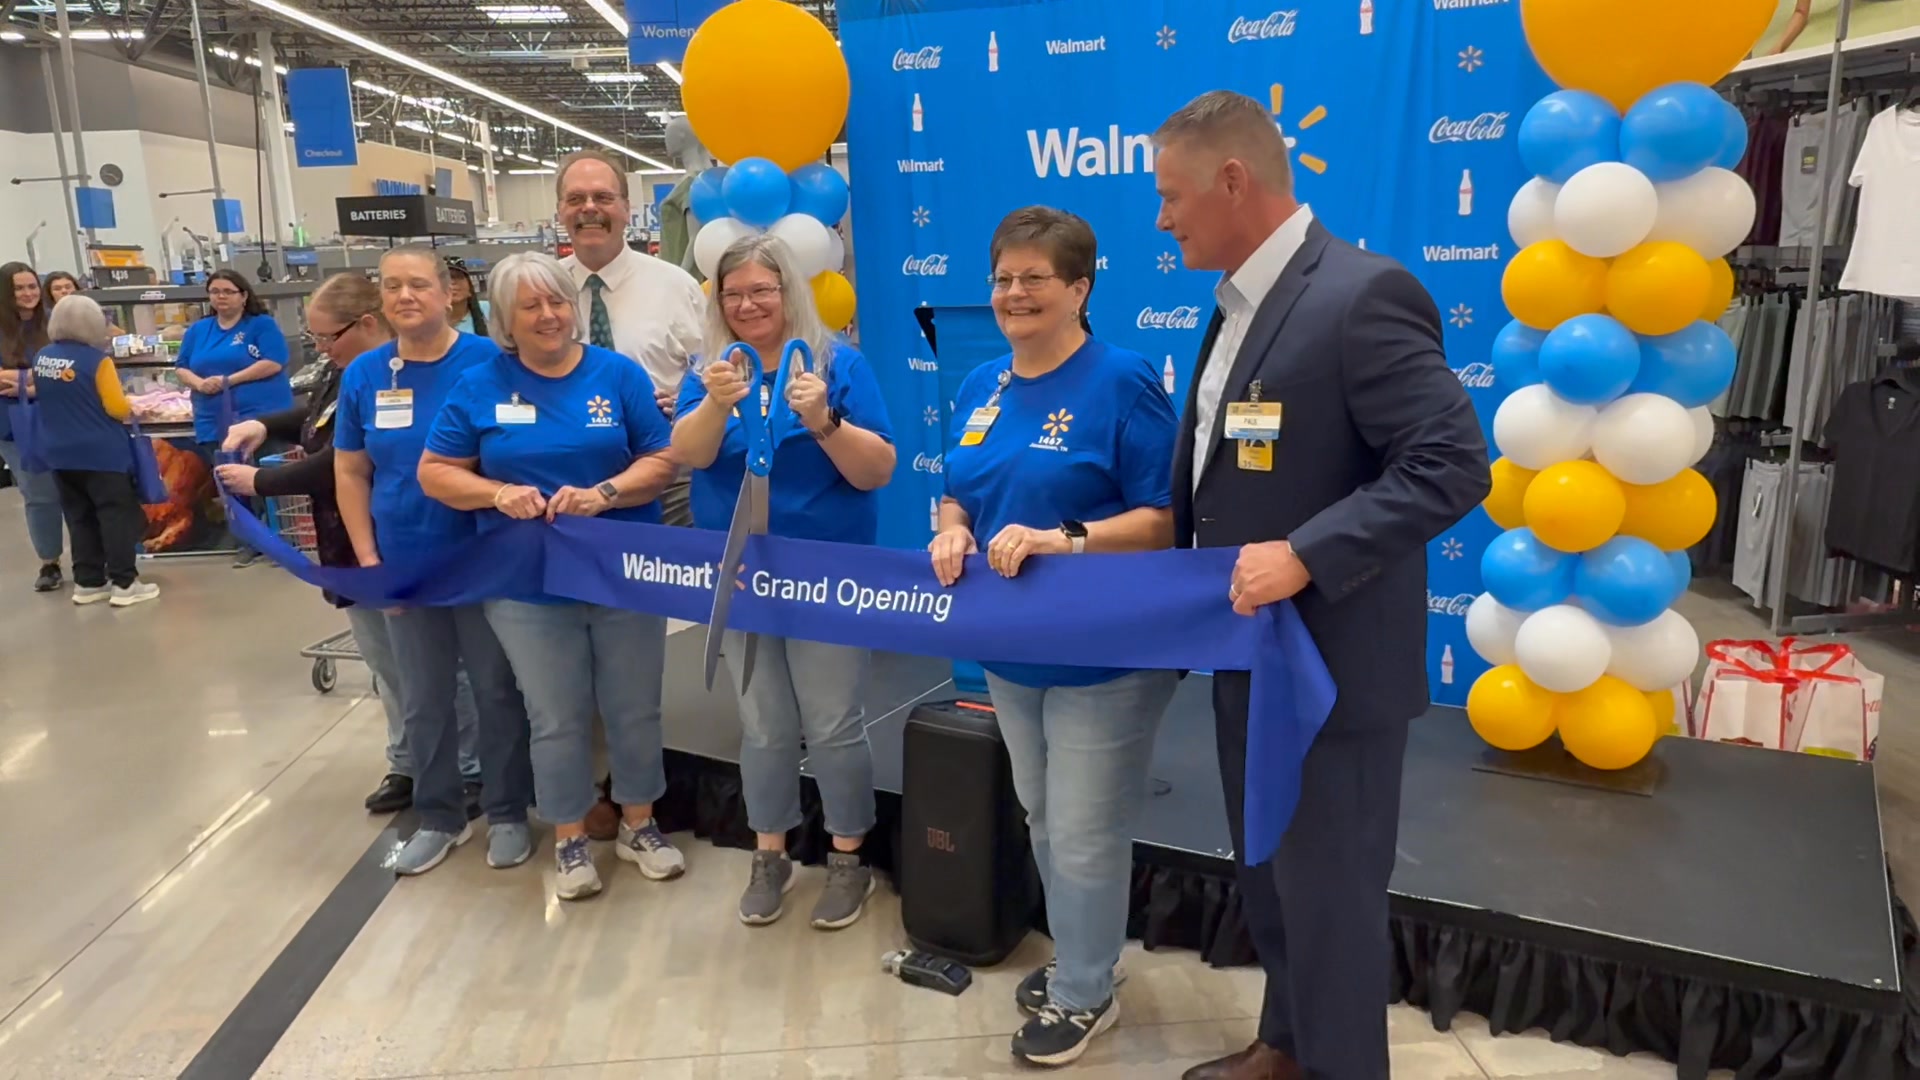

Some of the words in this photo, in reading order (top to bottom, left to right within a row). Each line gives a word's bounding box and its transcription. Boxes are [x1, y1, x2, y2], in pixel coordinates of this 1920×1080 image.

[1045, 35, 1106, 55] Walmart
[350, 209, 407, 221] BATTERIES
[435, 206, 467, 224] BATTERIES
[1422, 243, 1499, 262] Walmart
[37, 355, 75, 369] Happy
[38, 366, 62, 380] Help
[1038, 435, 1063, 446] 1467
[622, 552, 713, 589] Walmart
[752, 571, 828, 604] Grand
[836, 578, 953, 622] Opening
[927, 827, 955, 852] JBL
